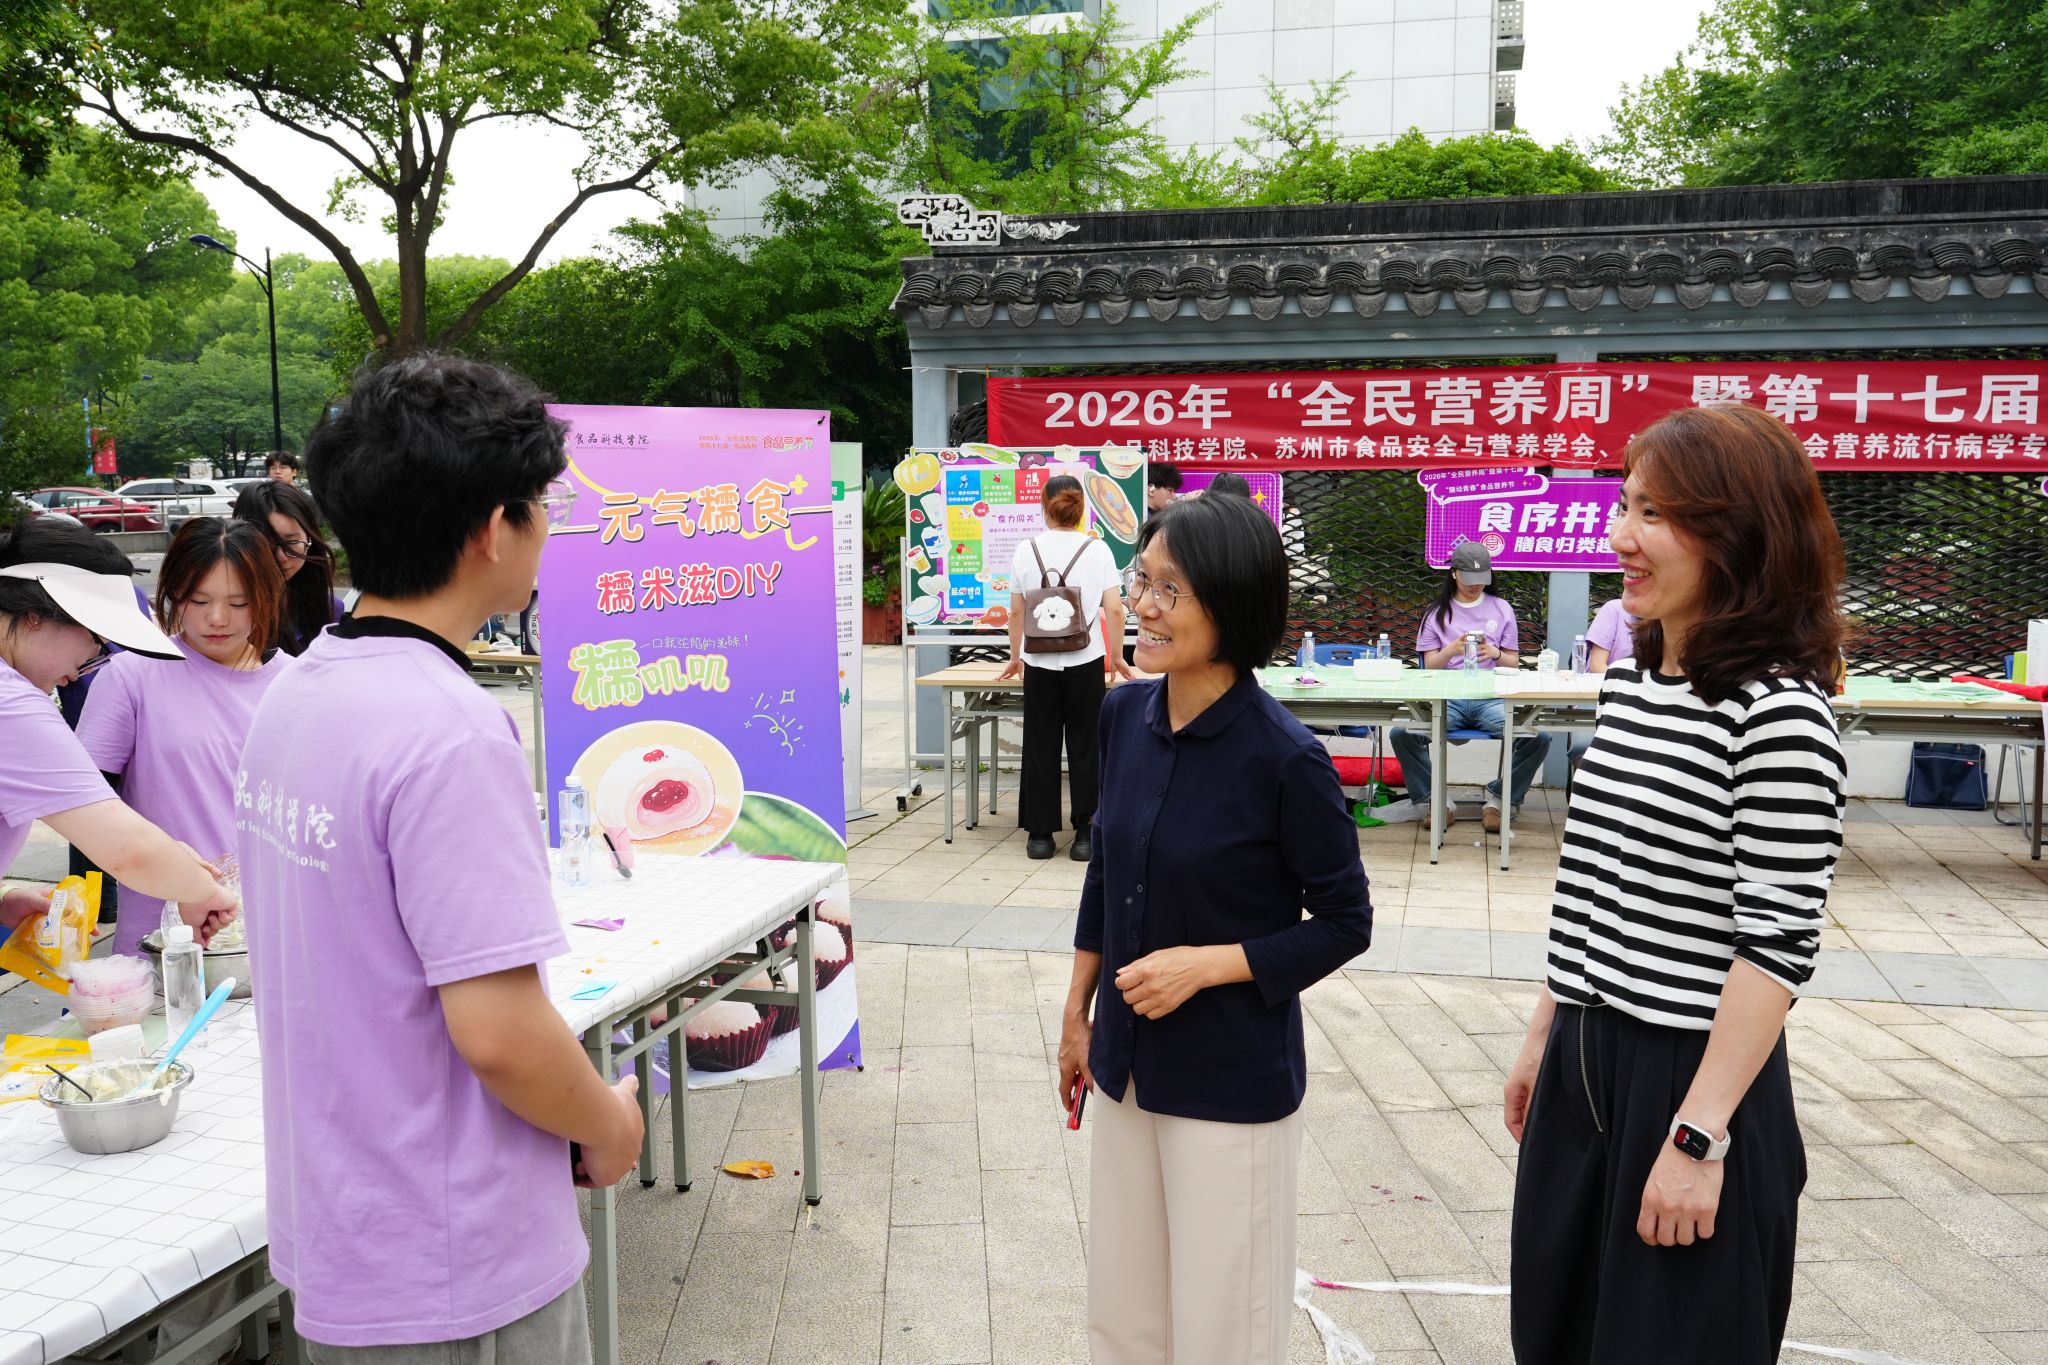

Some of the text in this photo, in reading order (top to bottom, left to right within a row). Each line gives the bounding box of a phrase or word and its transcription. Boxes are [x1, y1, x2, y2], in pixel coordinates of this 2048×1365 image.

[575, 433, 649, 446] 食品科技学院
[1102, 432, 2047, 462] 科技学院、苏州市食品安全与营养学会、 会营养流行病学专
[596, 561, 782, 615] 糯米滋DIY
[570, 640, 730, 709] 糯叽叽
